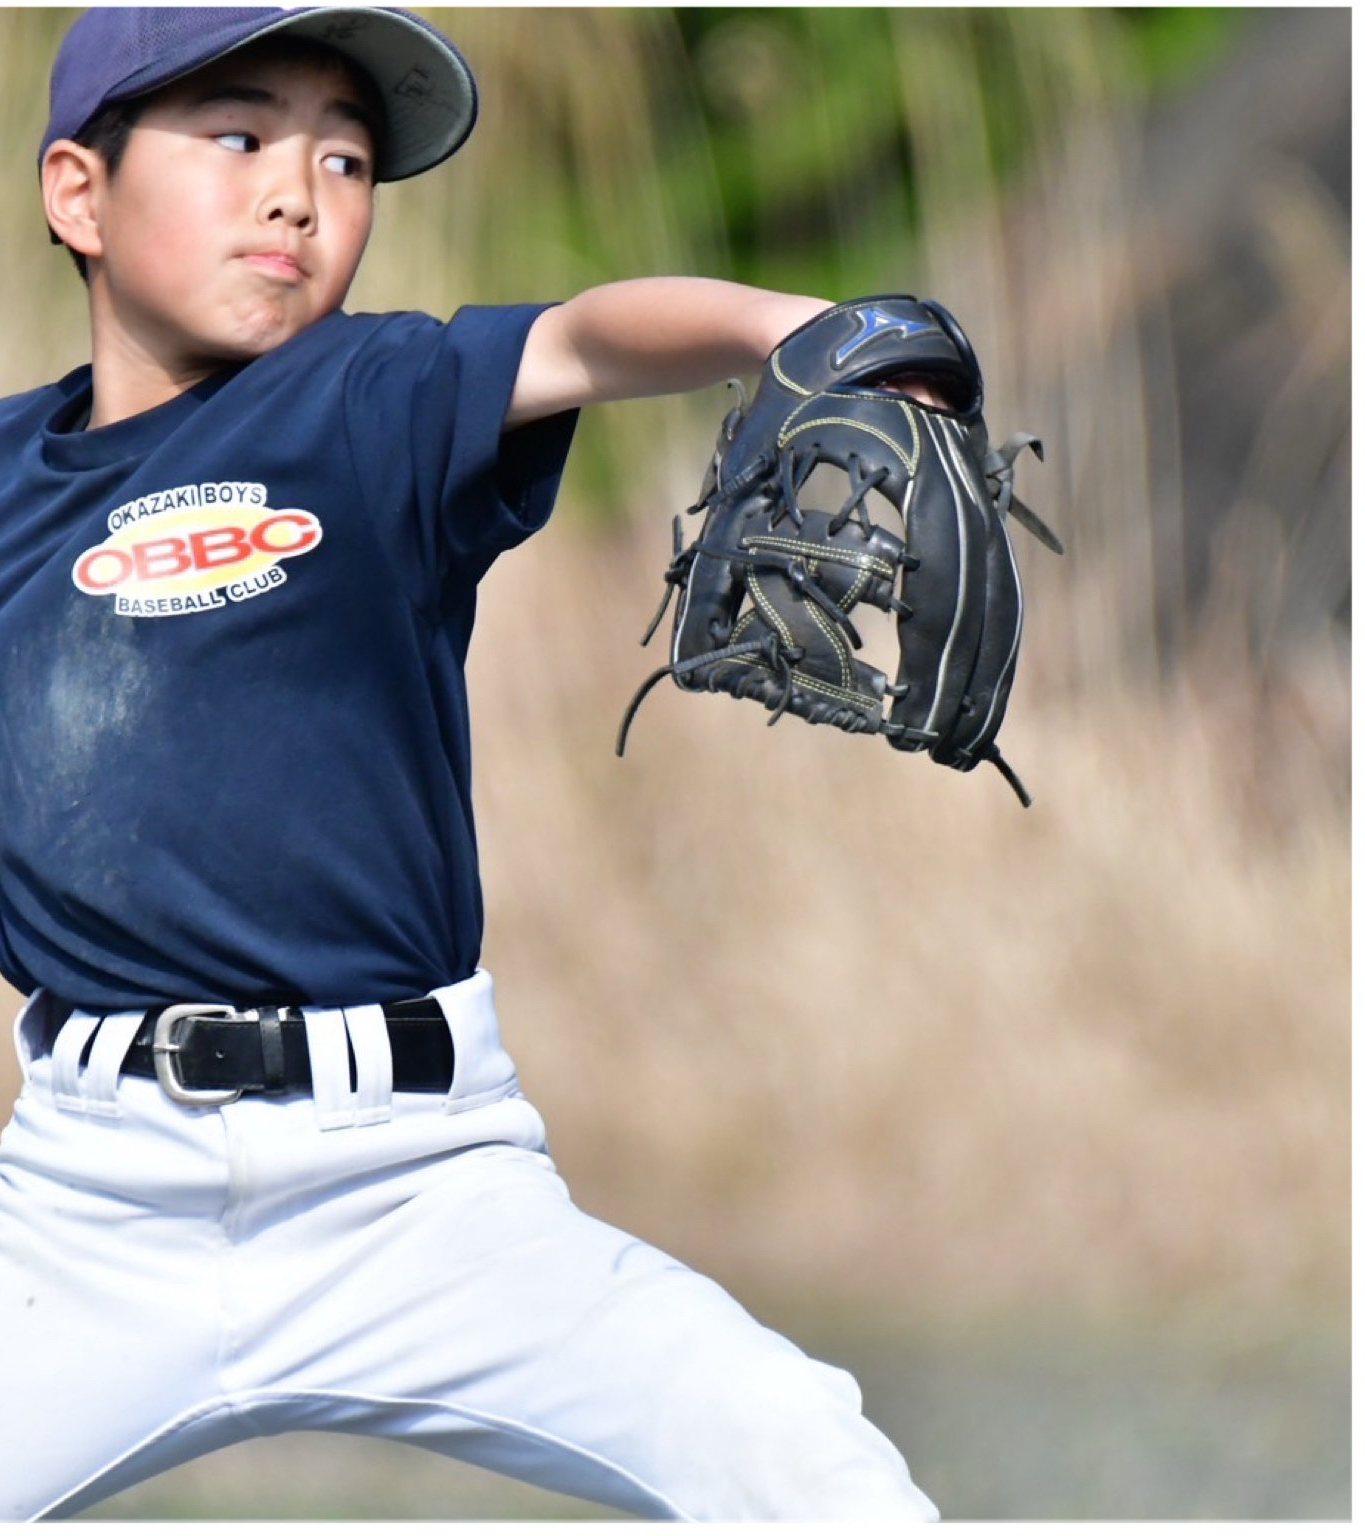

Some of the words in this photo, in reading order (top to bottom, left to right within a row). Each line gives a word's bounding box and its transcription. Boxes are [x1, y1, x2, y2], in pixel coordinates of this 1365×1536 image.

[111, 488, 197, 530] OKAZAKI
[205, 485, 263, 504] BOYS
[77, 514, 317, 589] OBBC
[118, 591, 222, 613] BASEBALL
[230, 568, 283, 599] CLUB
